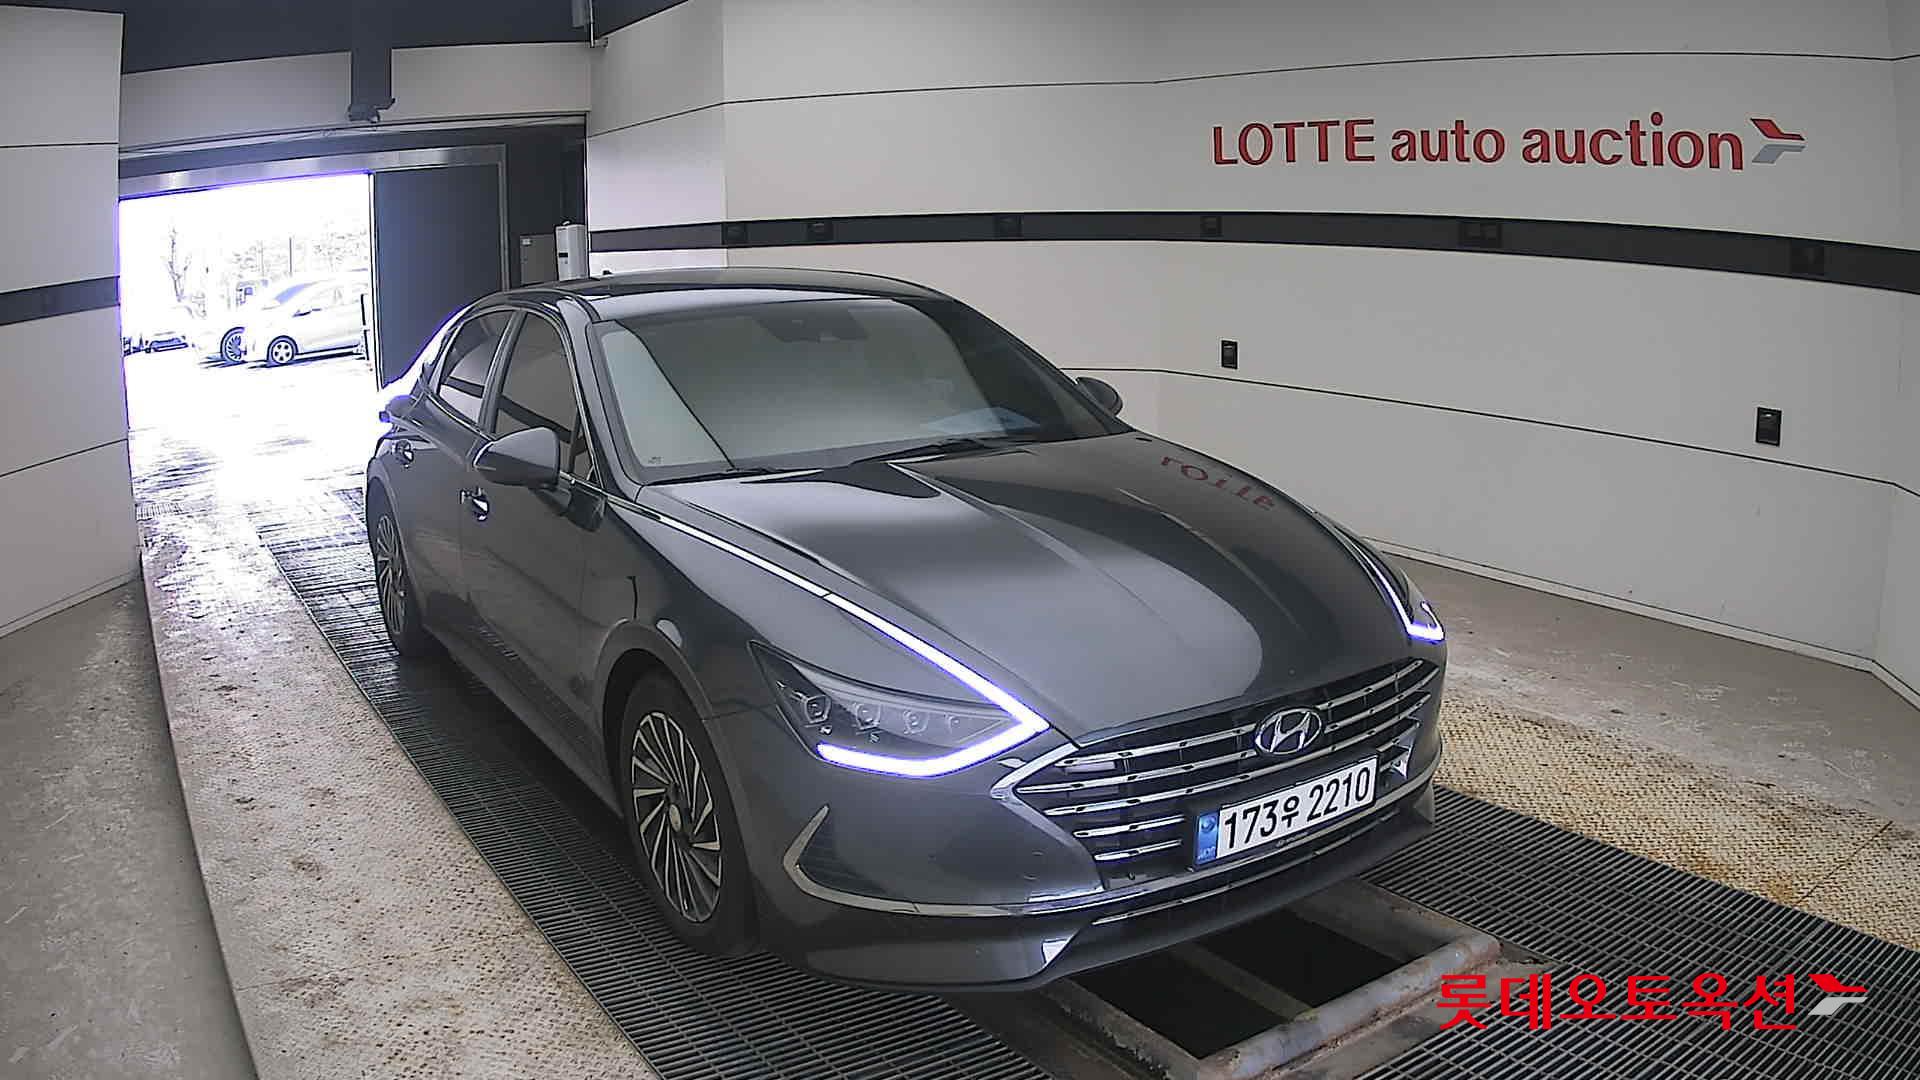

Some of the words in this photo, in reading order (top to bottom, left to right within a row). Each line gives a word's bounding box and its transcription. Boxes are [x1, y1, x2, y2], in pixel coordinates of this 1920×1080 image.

[1212, 119, 1376, 165] LOTTE
[1391, 119, 1505, 163] auto
[1522, 111, 1745, 171] auction
[1224, 796, 1300, 849] 173우
[1306, 766, 1371, 822] 2210
